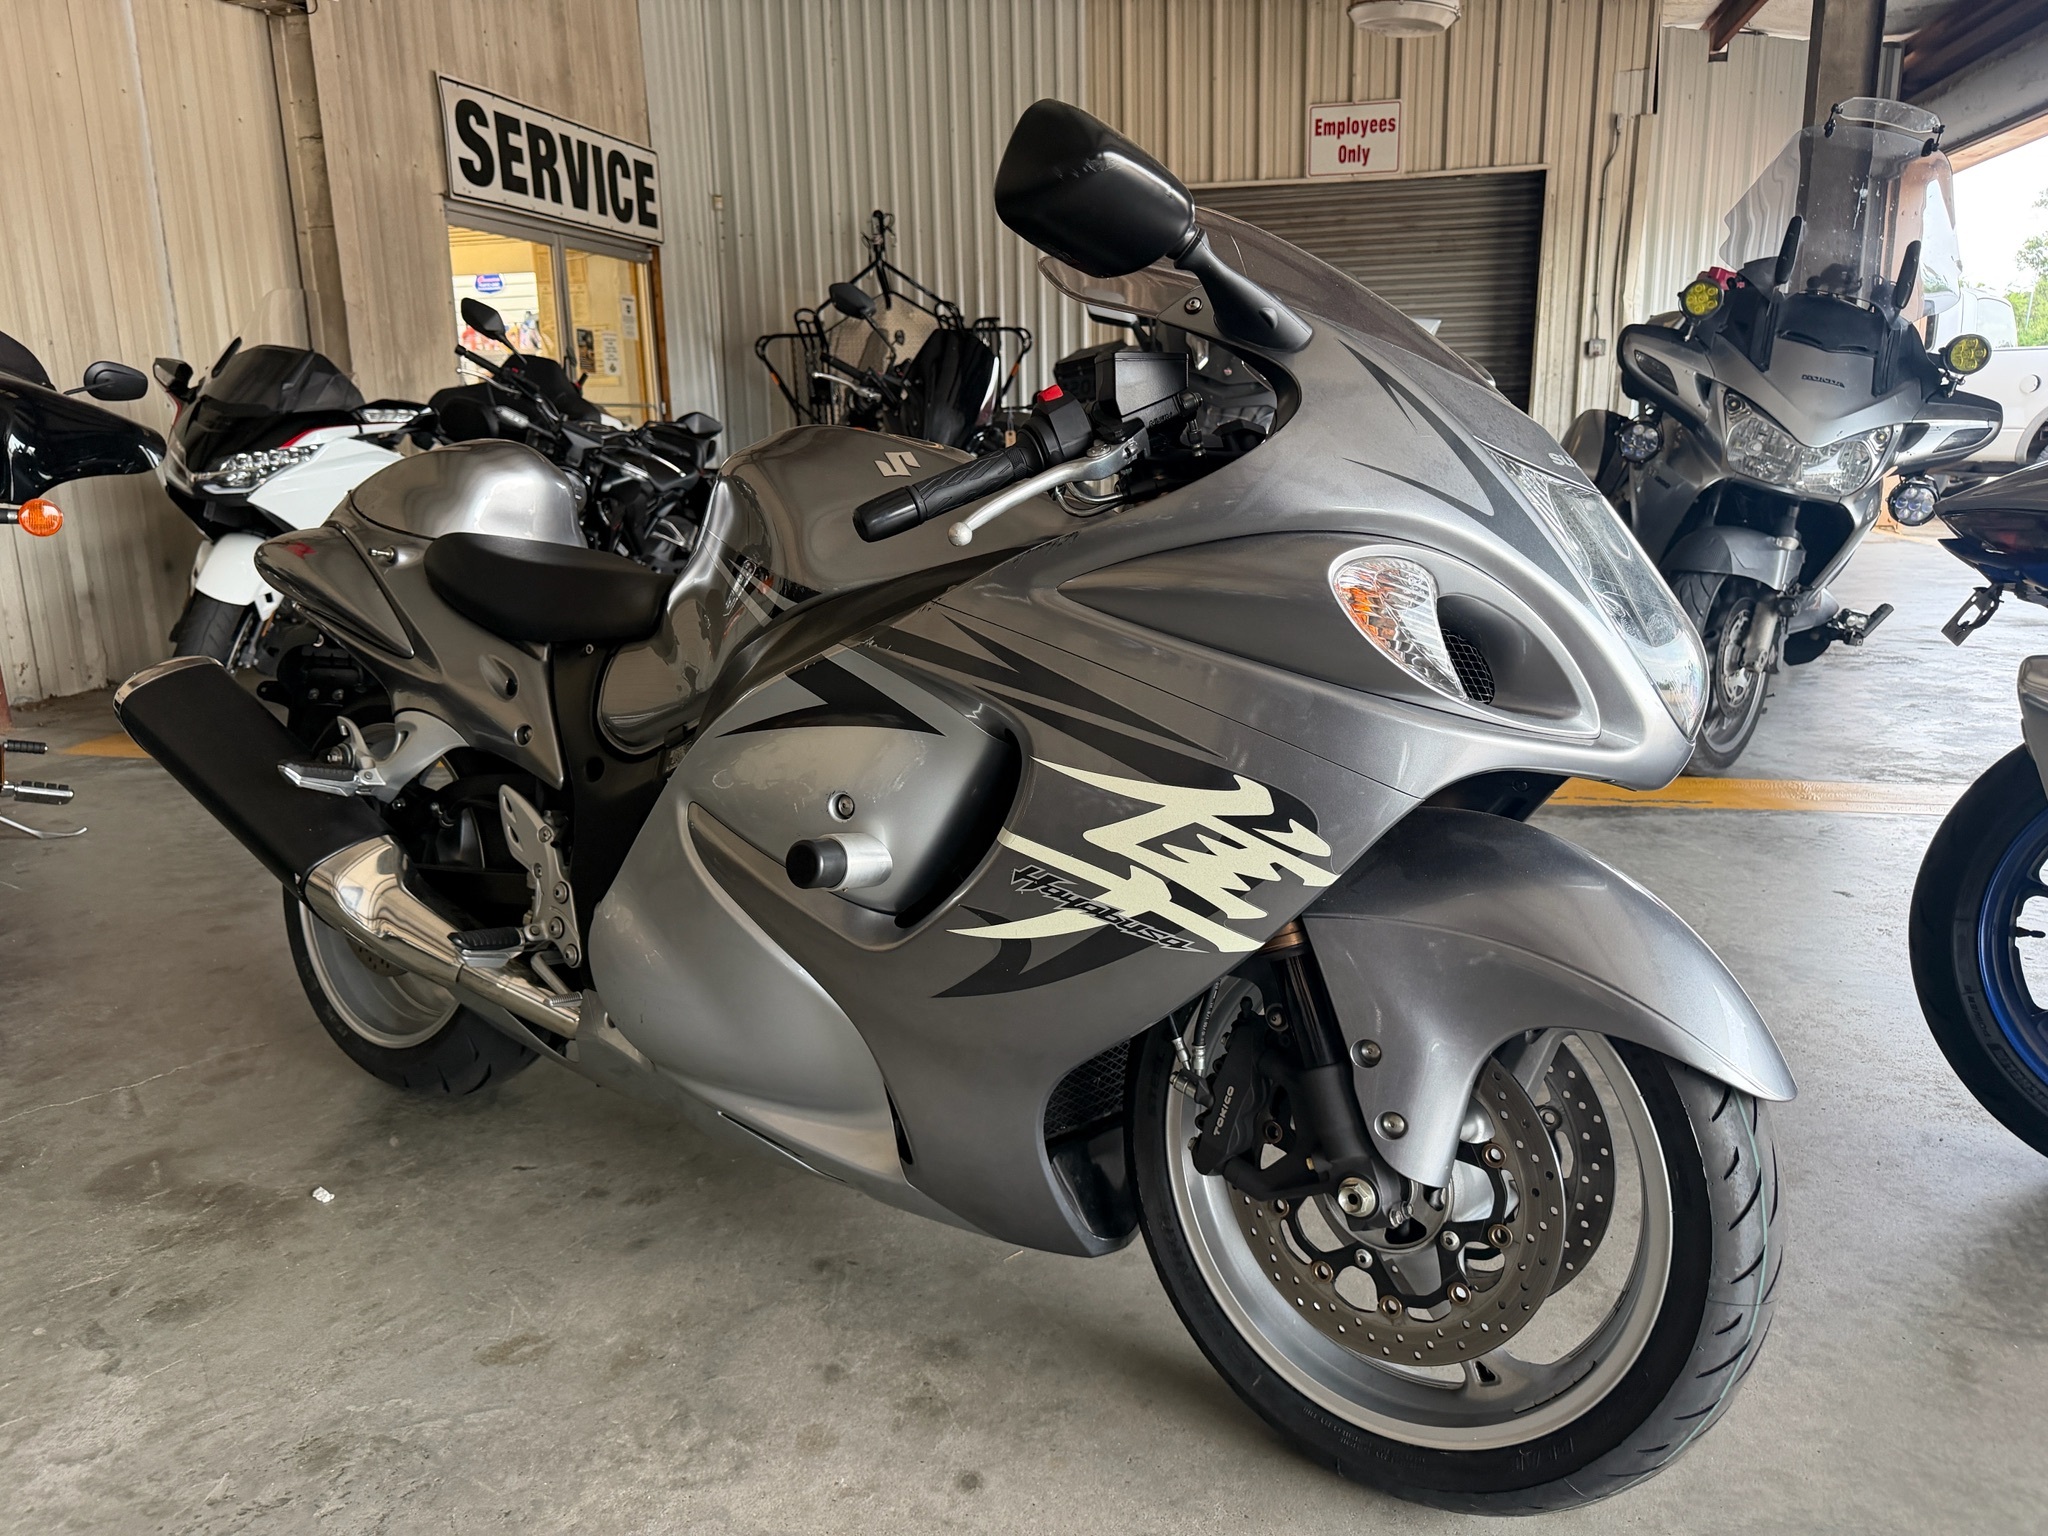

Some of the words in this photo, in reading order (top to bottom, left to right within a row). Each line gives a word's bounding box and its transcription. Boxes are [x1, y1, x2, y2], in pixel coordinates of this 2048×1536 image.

[1315, 116, 1396, 140] Employees
[455, 99, 658, 229] SERVICE
[1338, 144, 1370, 167] Only
[1011, 864, 1210, 953] Hayabusa
[1213, 1085, 1235, 1136] TOKICO
